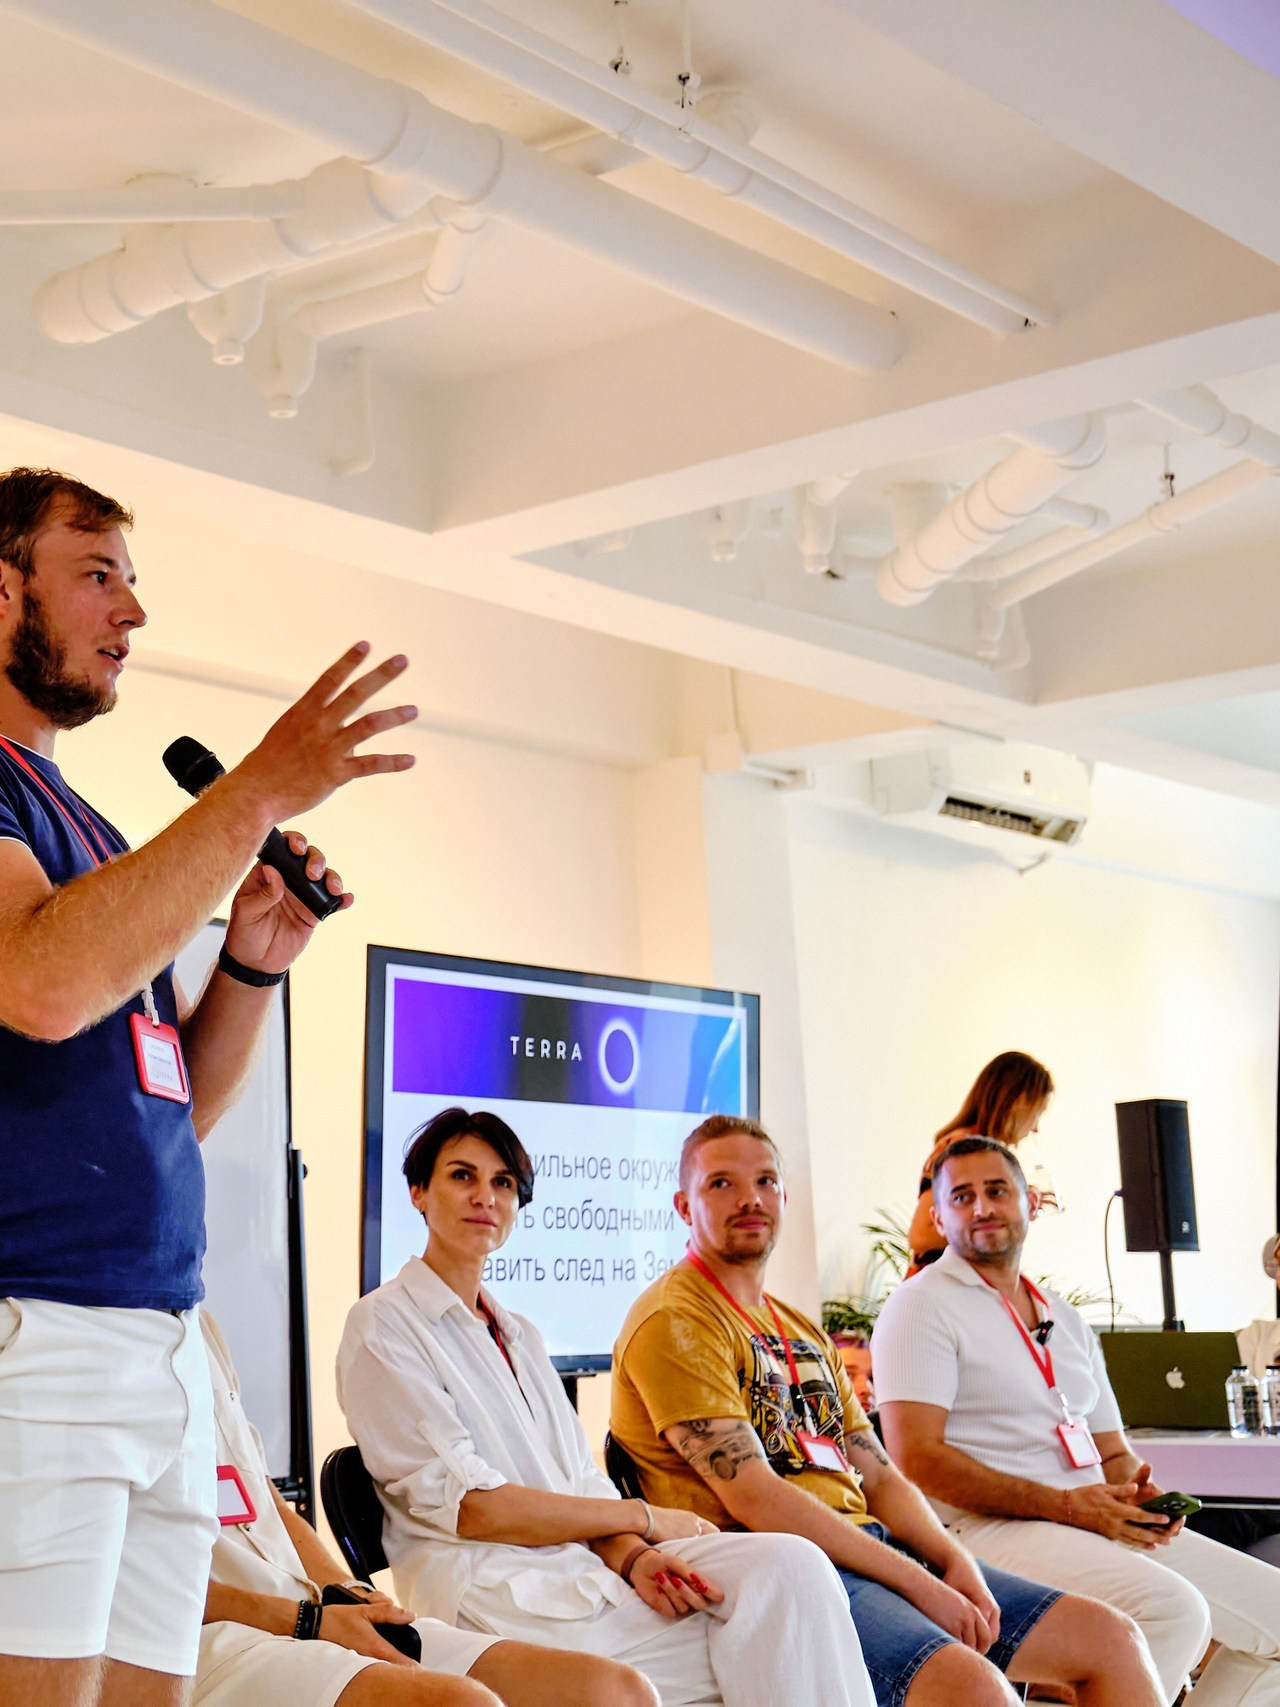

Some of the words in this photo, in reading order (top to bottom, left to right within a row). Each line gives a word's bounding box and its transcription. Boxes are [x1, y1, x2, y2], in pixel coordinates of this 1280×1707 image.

[509, 1035, 583, 1062] TERRA
[532, 1153, 612, 1181] ильное
[542, 1198, 675, 1236] свободными
[481, 1257, 547, 1282] авить
[553, 1257, 606, 1287] след
[612, 1257, 636, 1282] на
[643, 1250, 674, 1281] Зе
